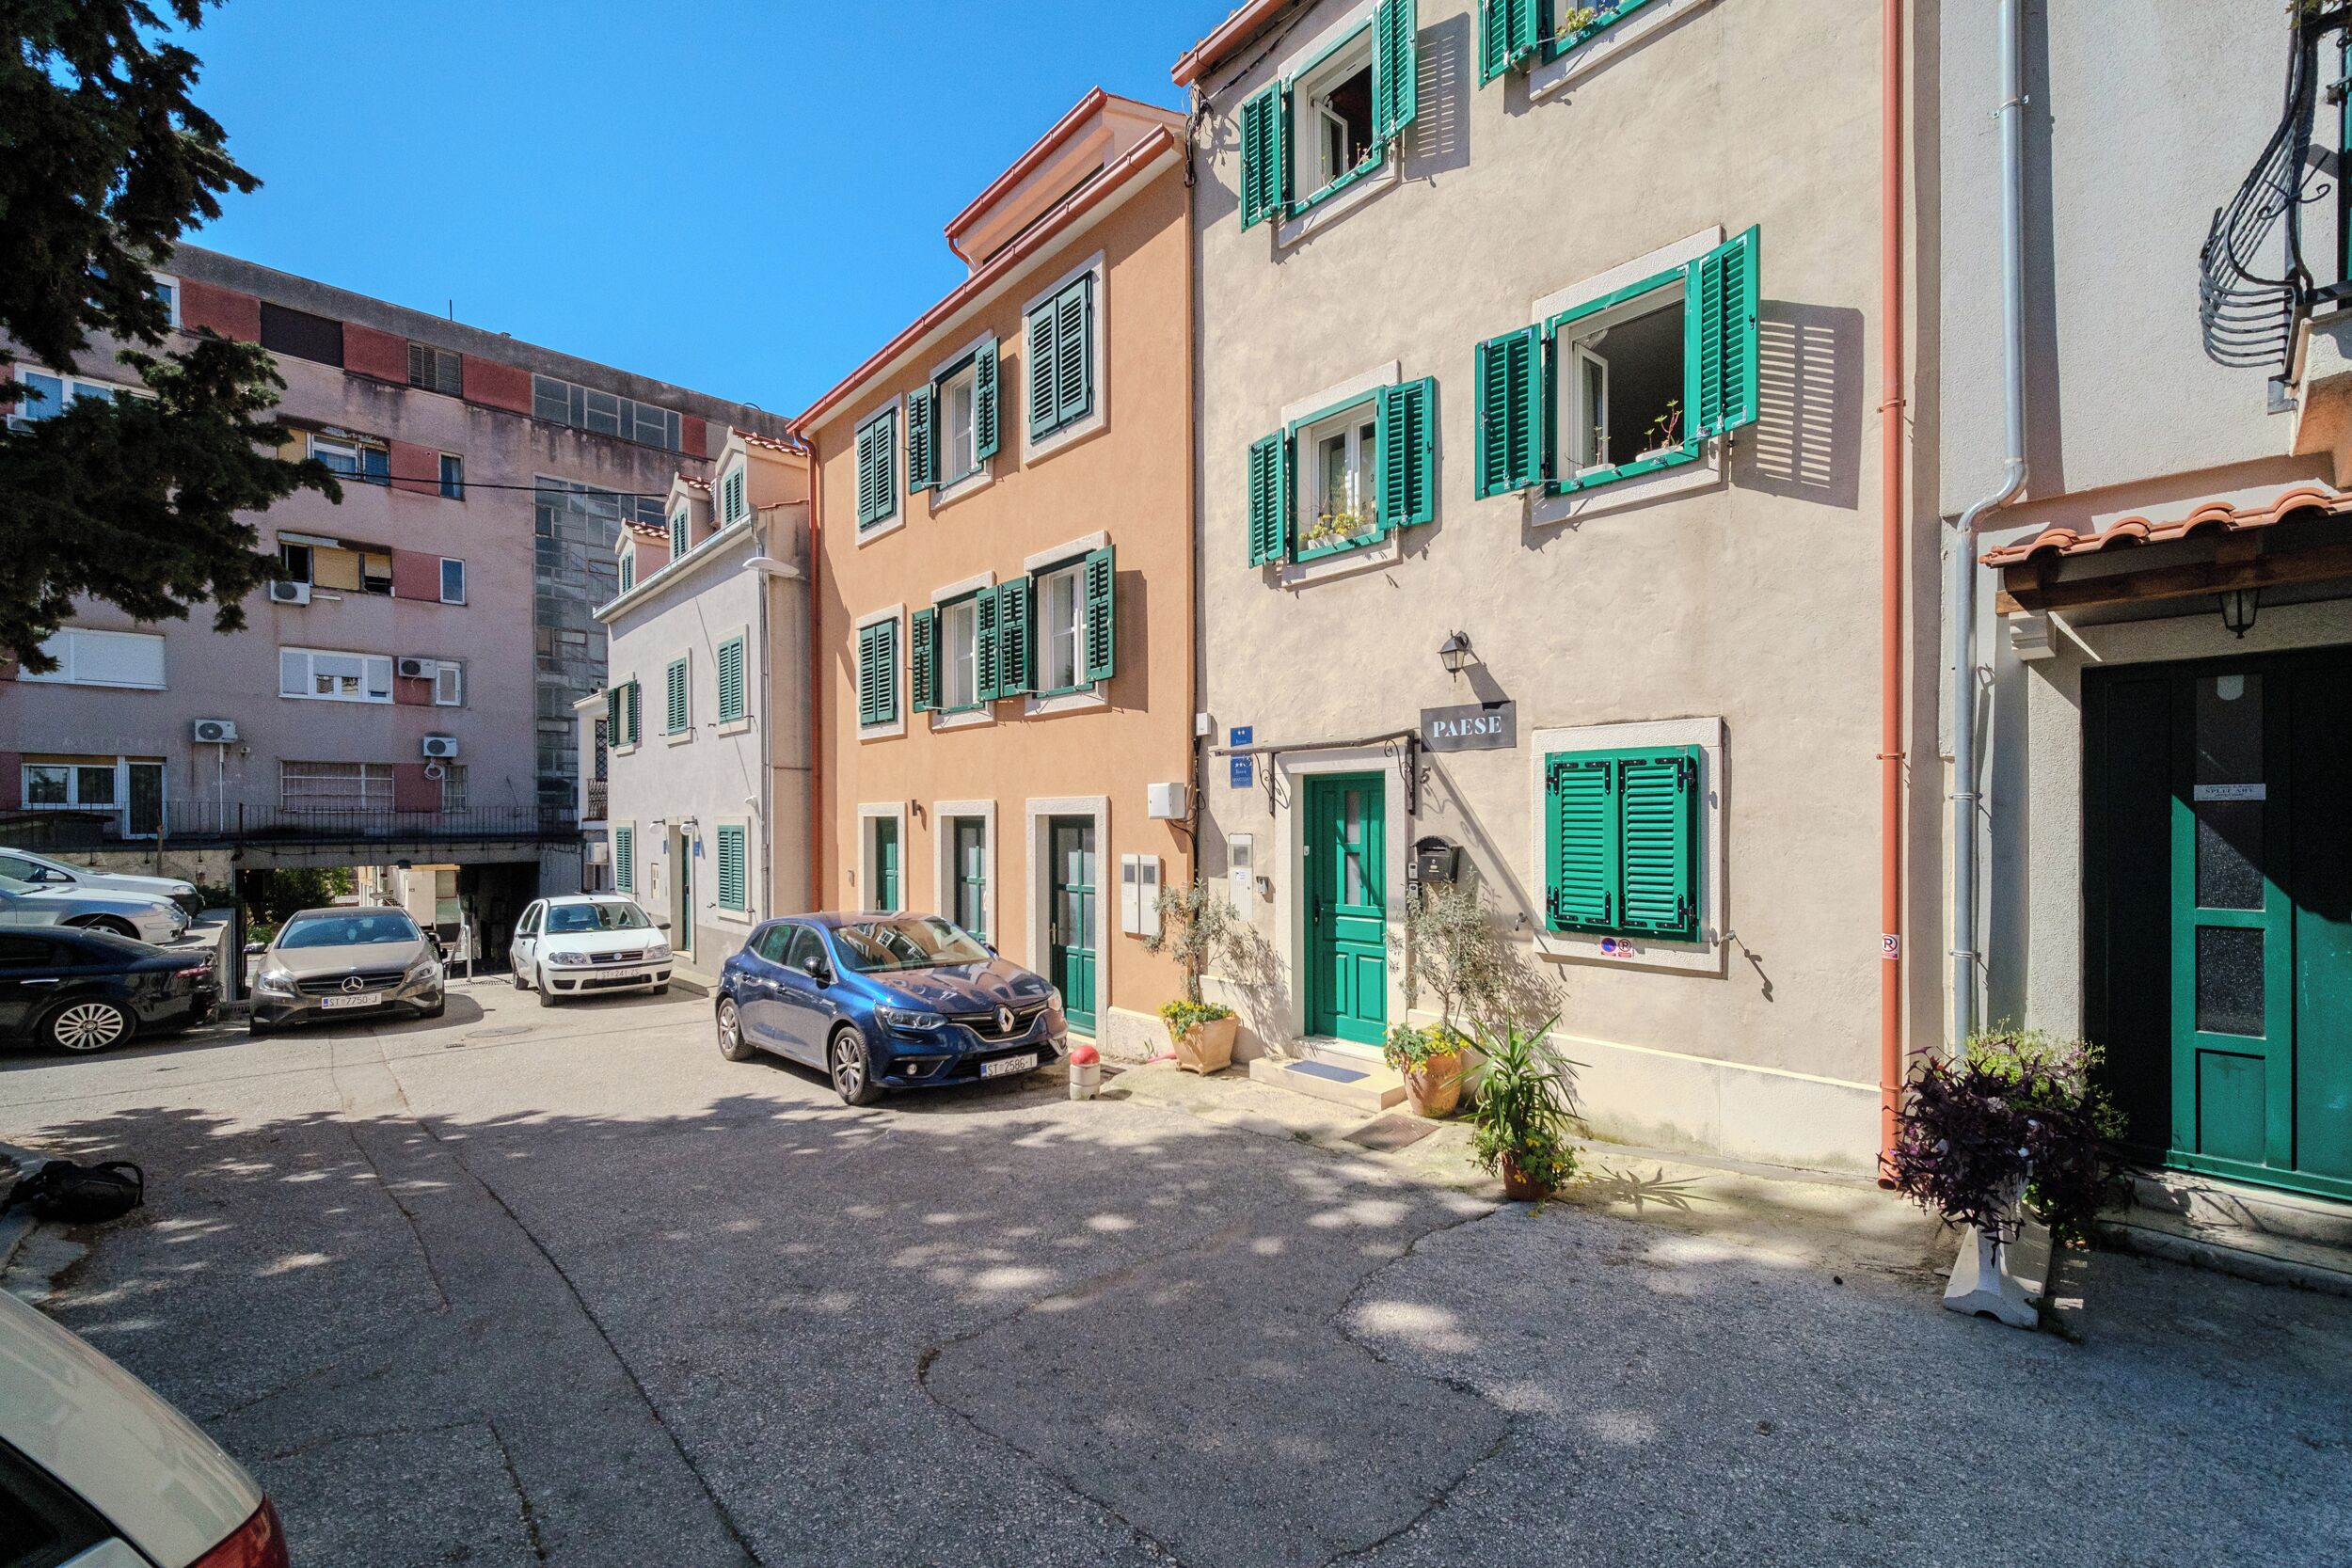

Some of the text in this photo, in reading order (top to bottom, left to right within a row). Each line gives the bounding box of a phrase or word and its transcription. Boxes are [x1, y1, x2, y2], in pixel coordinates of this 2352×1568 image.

[1433, 716, 1502, 738] PAESE
[329, 998, 340, 1006] ST
[987, 1064, 999, 1077] ST
